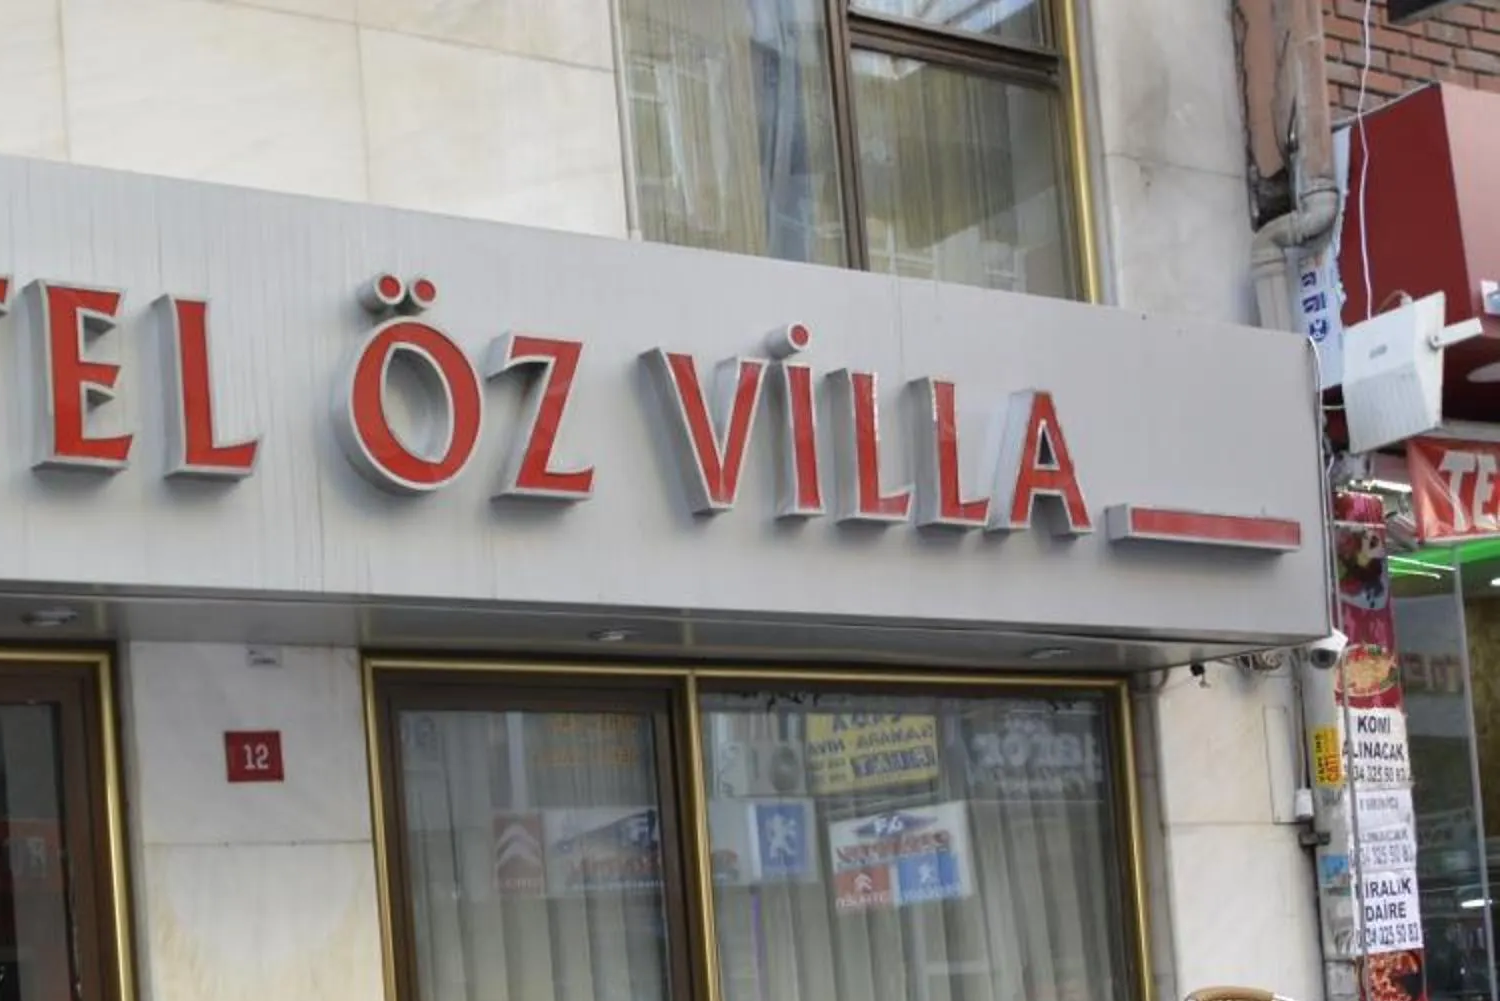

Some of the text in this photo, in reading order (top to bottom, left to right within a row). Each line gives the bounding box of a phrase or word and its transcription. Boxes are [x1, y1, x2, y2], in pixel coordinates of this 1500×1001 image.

[334, 273, 594, 501] ÖZ
[640, 323, 1094, 538] VİLLA
[243, 743, 270, 770] 12
